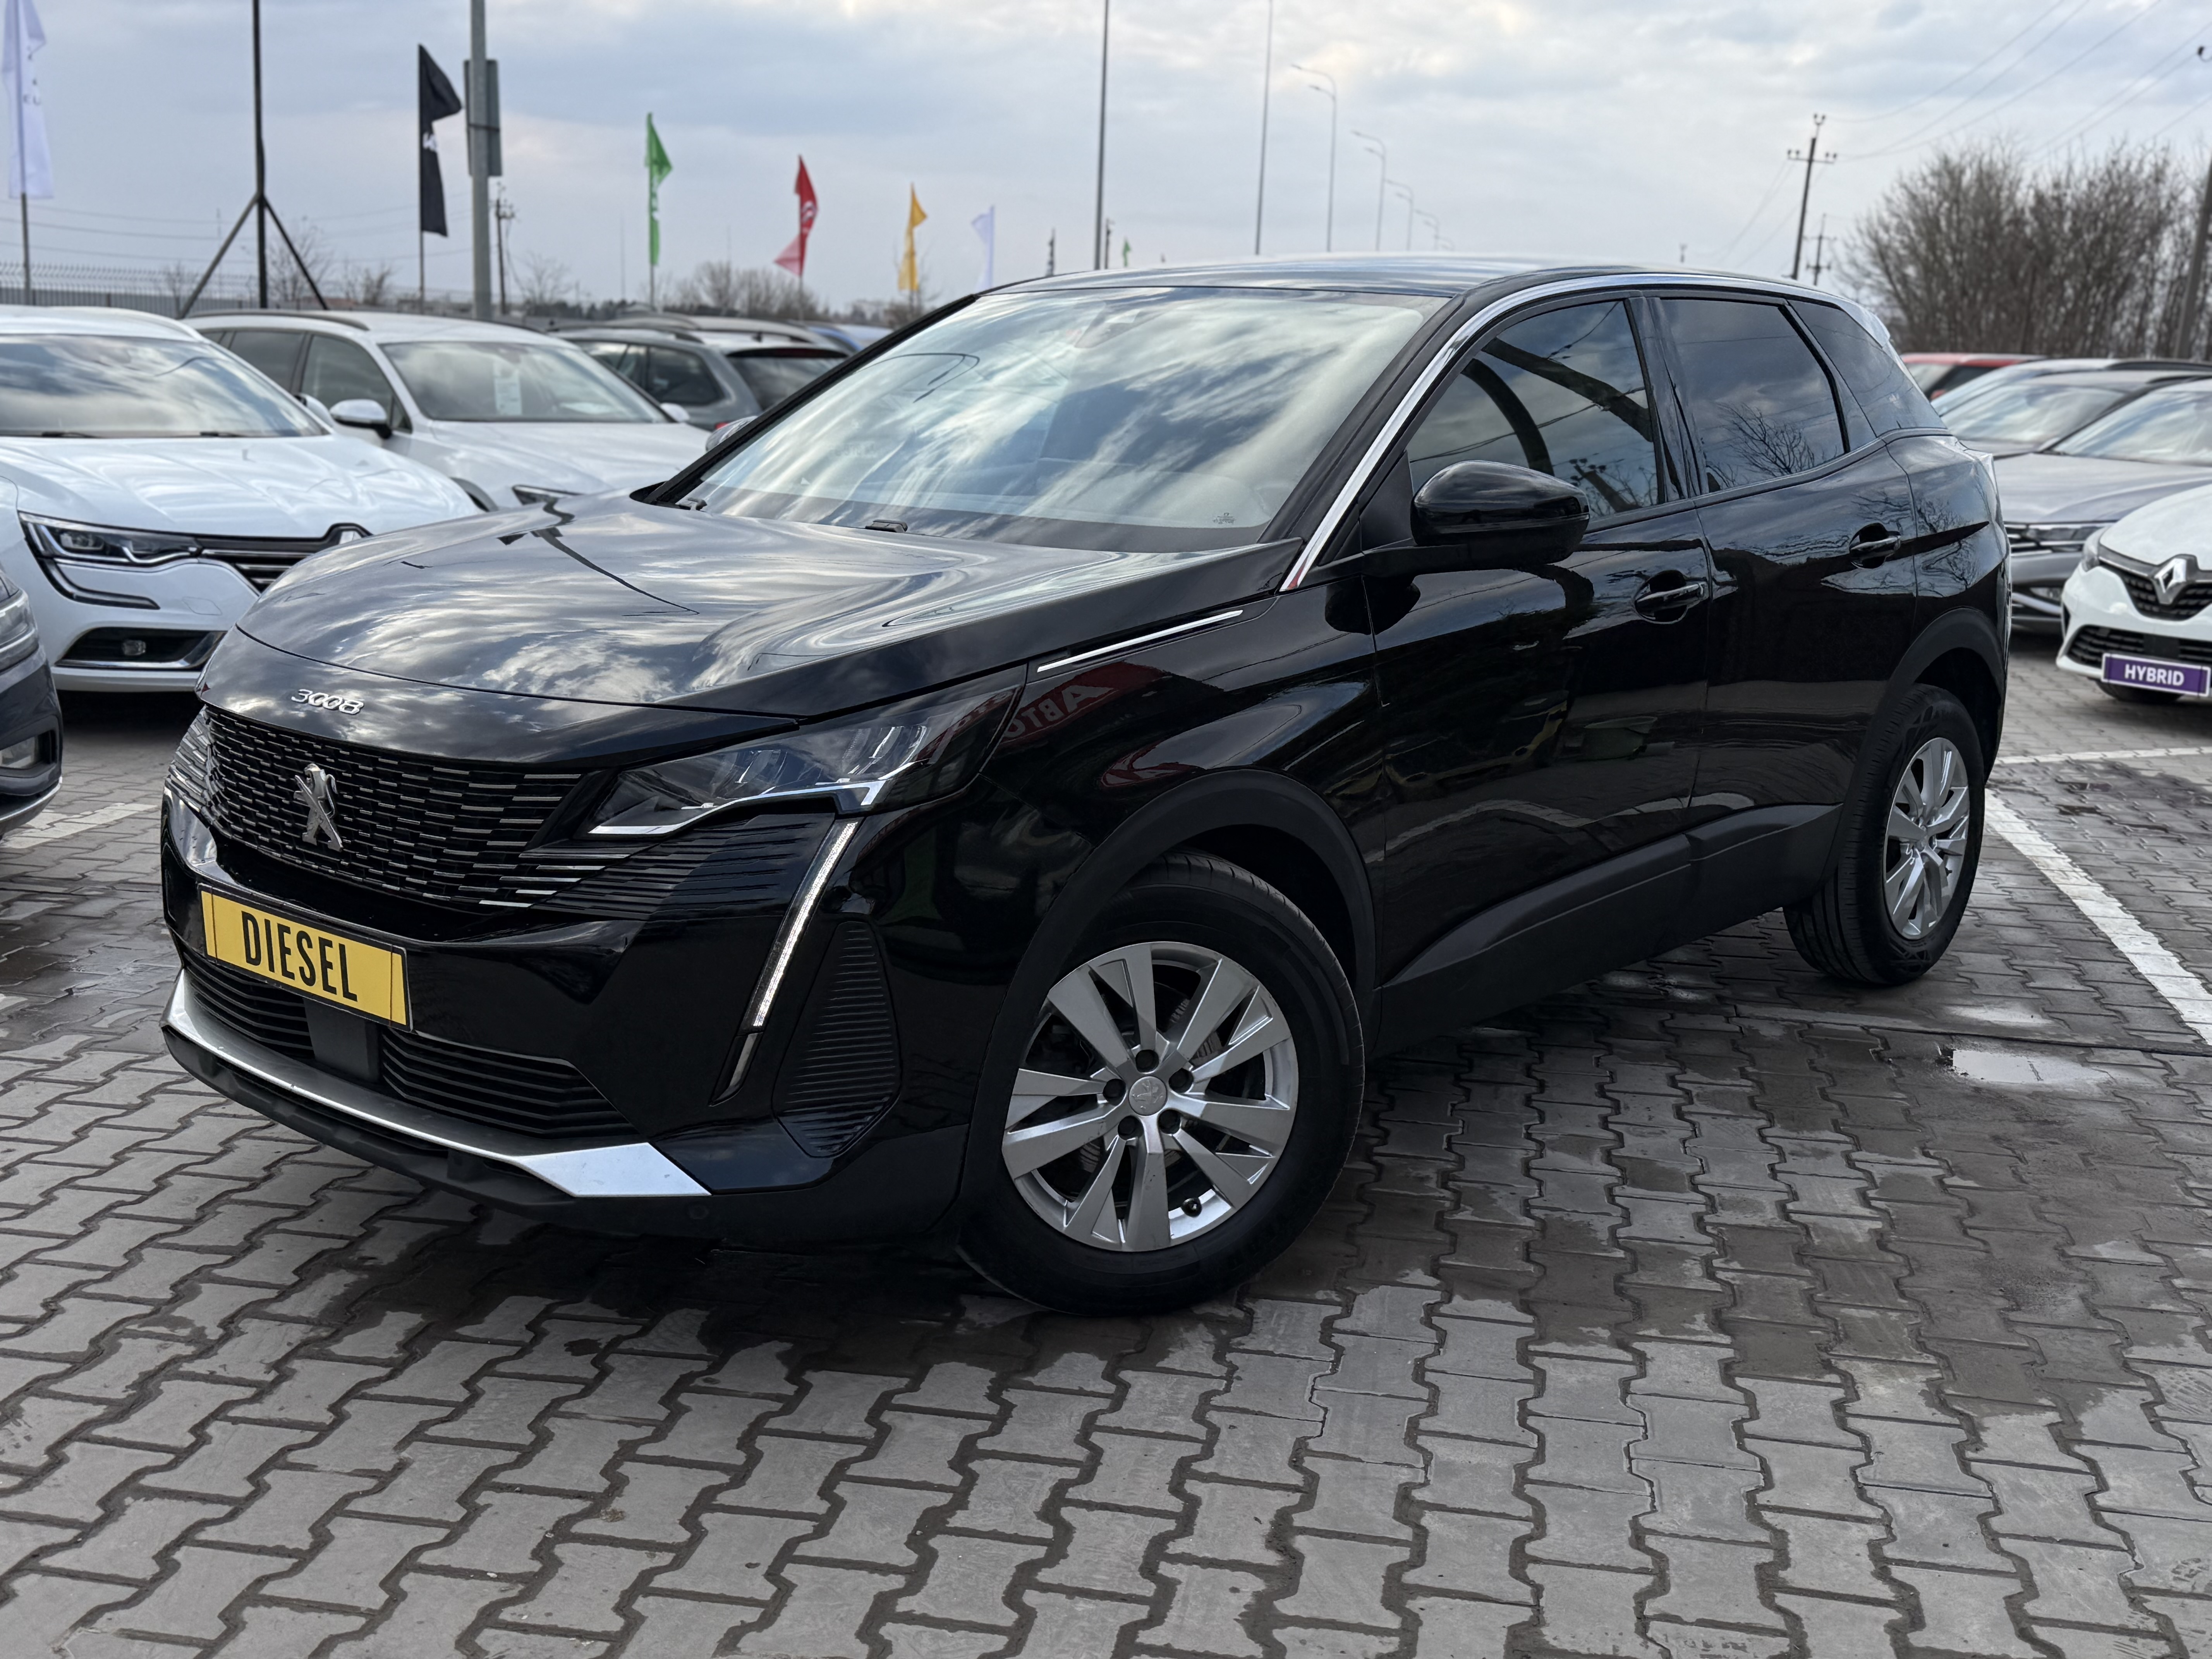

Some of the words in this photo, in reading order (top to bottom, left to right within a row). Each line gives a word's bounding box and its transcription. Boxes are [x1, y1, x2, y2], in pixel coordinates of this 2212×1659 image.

[2124, 664, 2185, 686] HYBRID
[291, 689, 364, 714] 3008
[241, 910, 358, 1002] DIESEL
